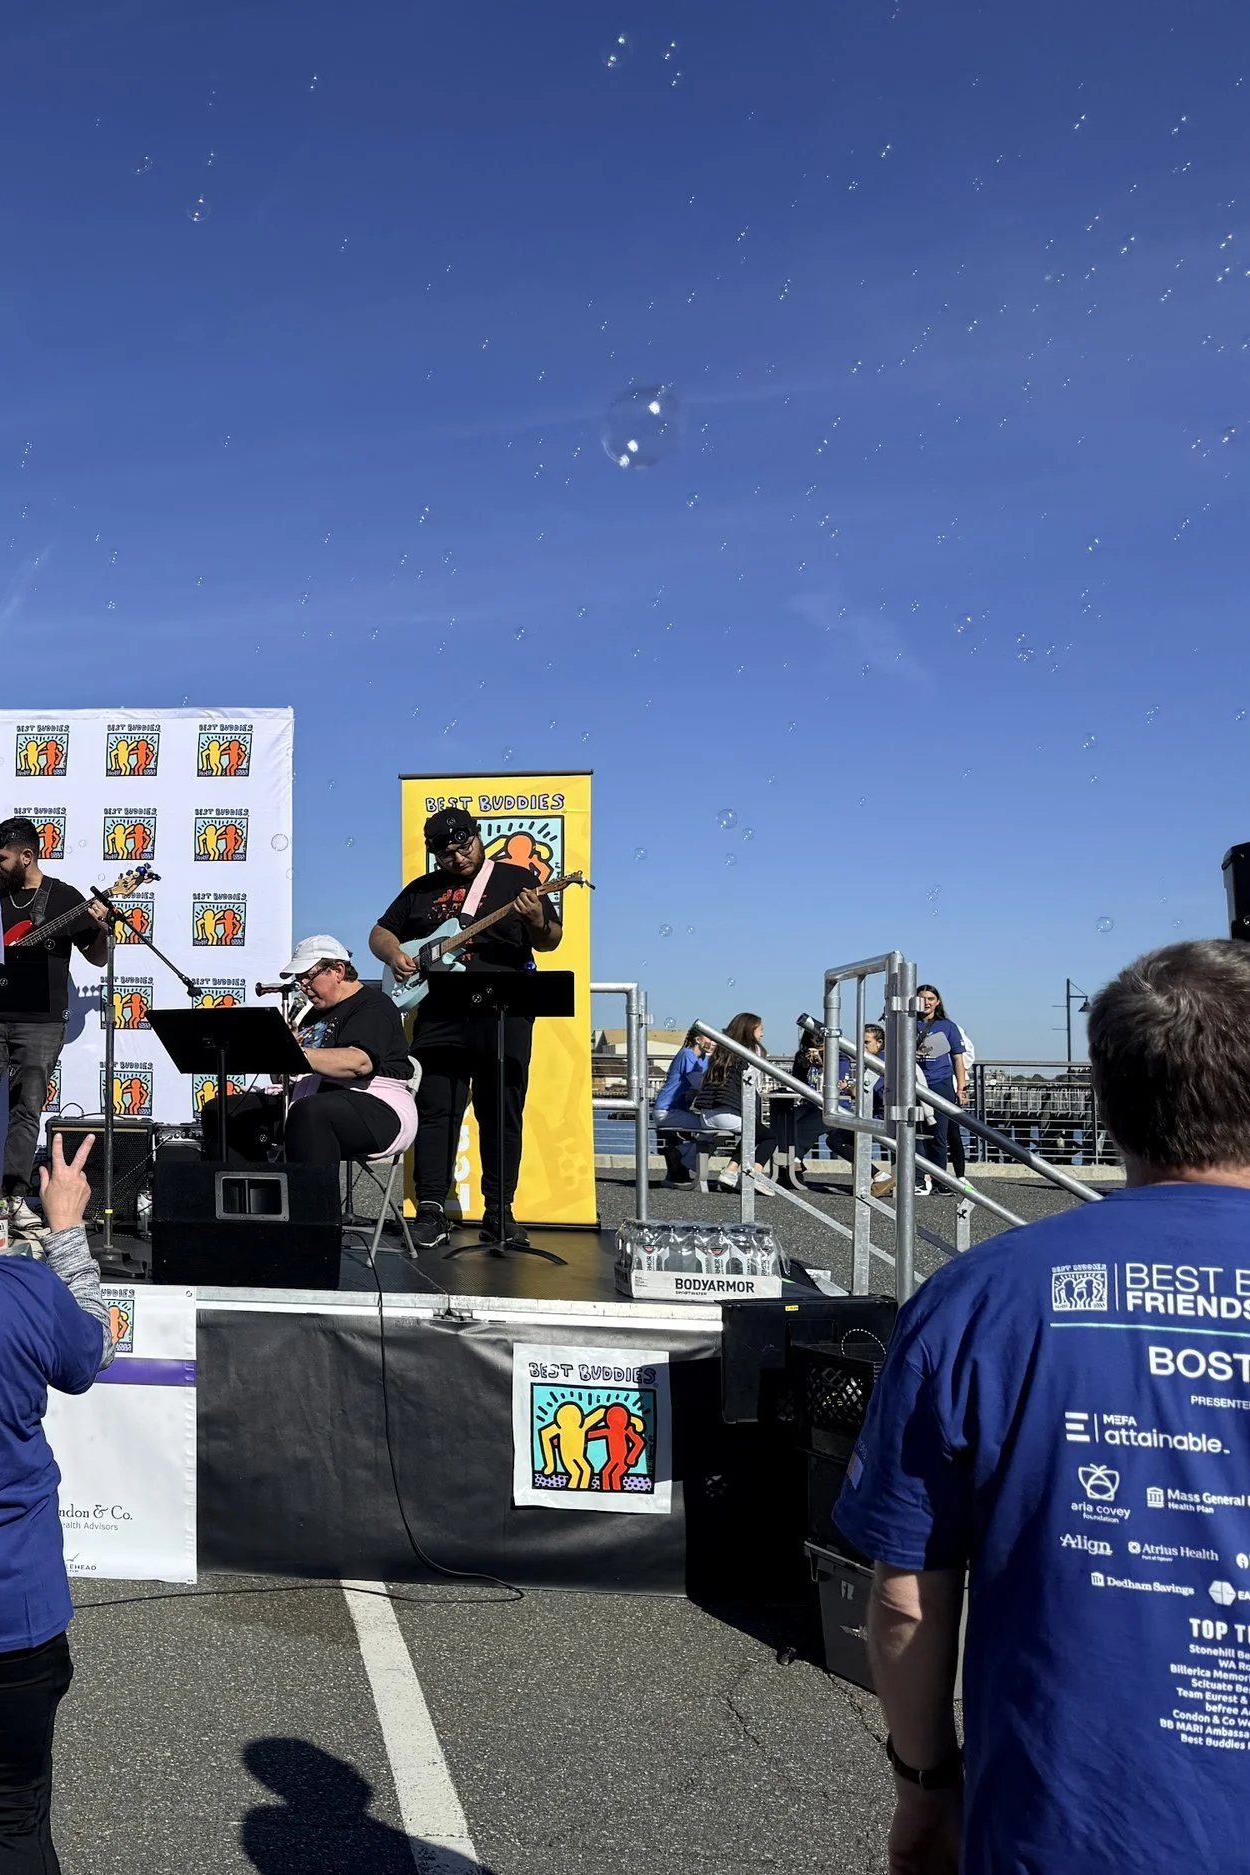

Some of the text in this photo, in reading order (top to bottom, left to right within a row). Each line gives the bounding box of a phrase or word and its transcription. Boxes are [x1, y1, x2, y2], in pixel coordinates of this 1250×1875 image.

[425, 794, 565, 812] BEST BUDDIES
[675, 1278, 755, 1294] BODYARMOR
[1126, 1263, 1224, 1294] BEST
[1126, 1291, 1250, 1320] FRIENDS
[529, 1362, 656, 1384] BEST BUDDIES
[1149, 1346, 1250, 1383] BOST
[1190, 1395, 1250, 1410] PRESENTE
[1103, 1413, 1137, 1426] MEFA
[1104, 1428, 1231, 1454] attainable.
[1167, 1488, 1245, 1507] Mass General
[59, 1504, 133, 1520] ndon & Co.
[1071, 1501, 1131, 1519] aria covey
[1168, 1502, 1215, 1514] Health Plan
[62, 1521, 119, 1531] ealth Advisors
[1083, 1513, 1120, 1524] foundation
[1060, 1533, 1113, 1556] Align
[1142, 1543, 1219, 1562] Atrius Health
[1107, 1576, 1195, 1597] Dedham Savings
[1237, 1592, 1250, 1601] EA
[1189, 1618, 1228, 1641] TOP
[1189, 1644, 1250, 1660] Stonehill Be
[1170, 1663, 1250, 1682] Billerica Memori
[1218, 1659, 1237, 1670] WA
[1191, 1678, 1250, 1694] Scituate Bes
[1176, 1687, 1248, 1704] Team Eurest &
[1205, 1702, 1239, 1715] befree
[1172, 1709, 1211, 1724] Condon
[1212, 1715, 1220, 1725] &
[1222, 1716, 1235, 1726] Co
[1159, 1718, 1250, 1739] BB MARI Ambassa
[1180, 1733, 1246, 1750] Best Buddies
